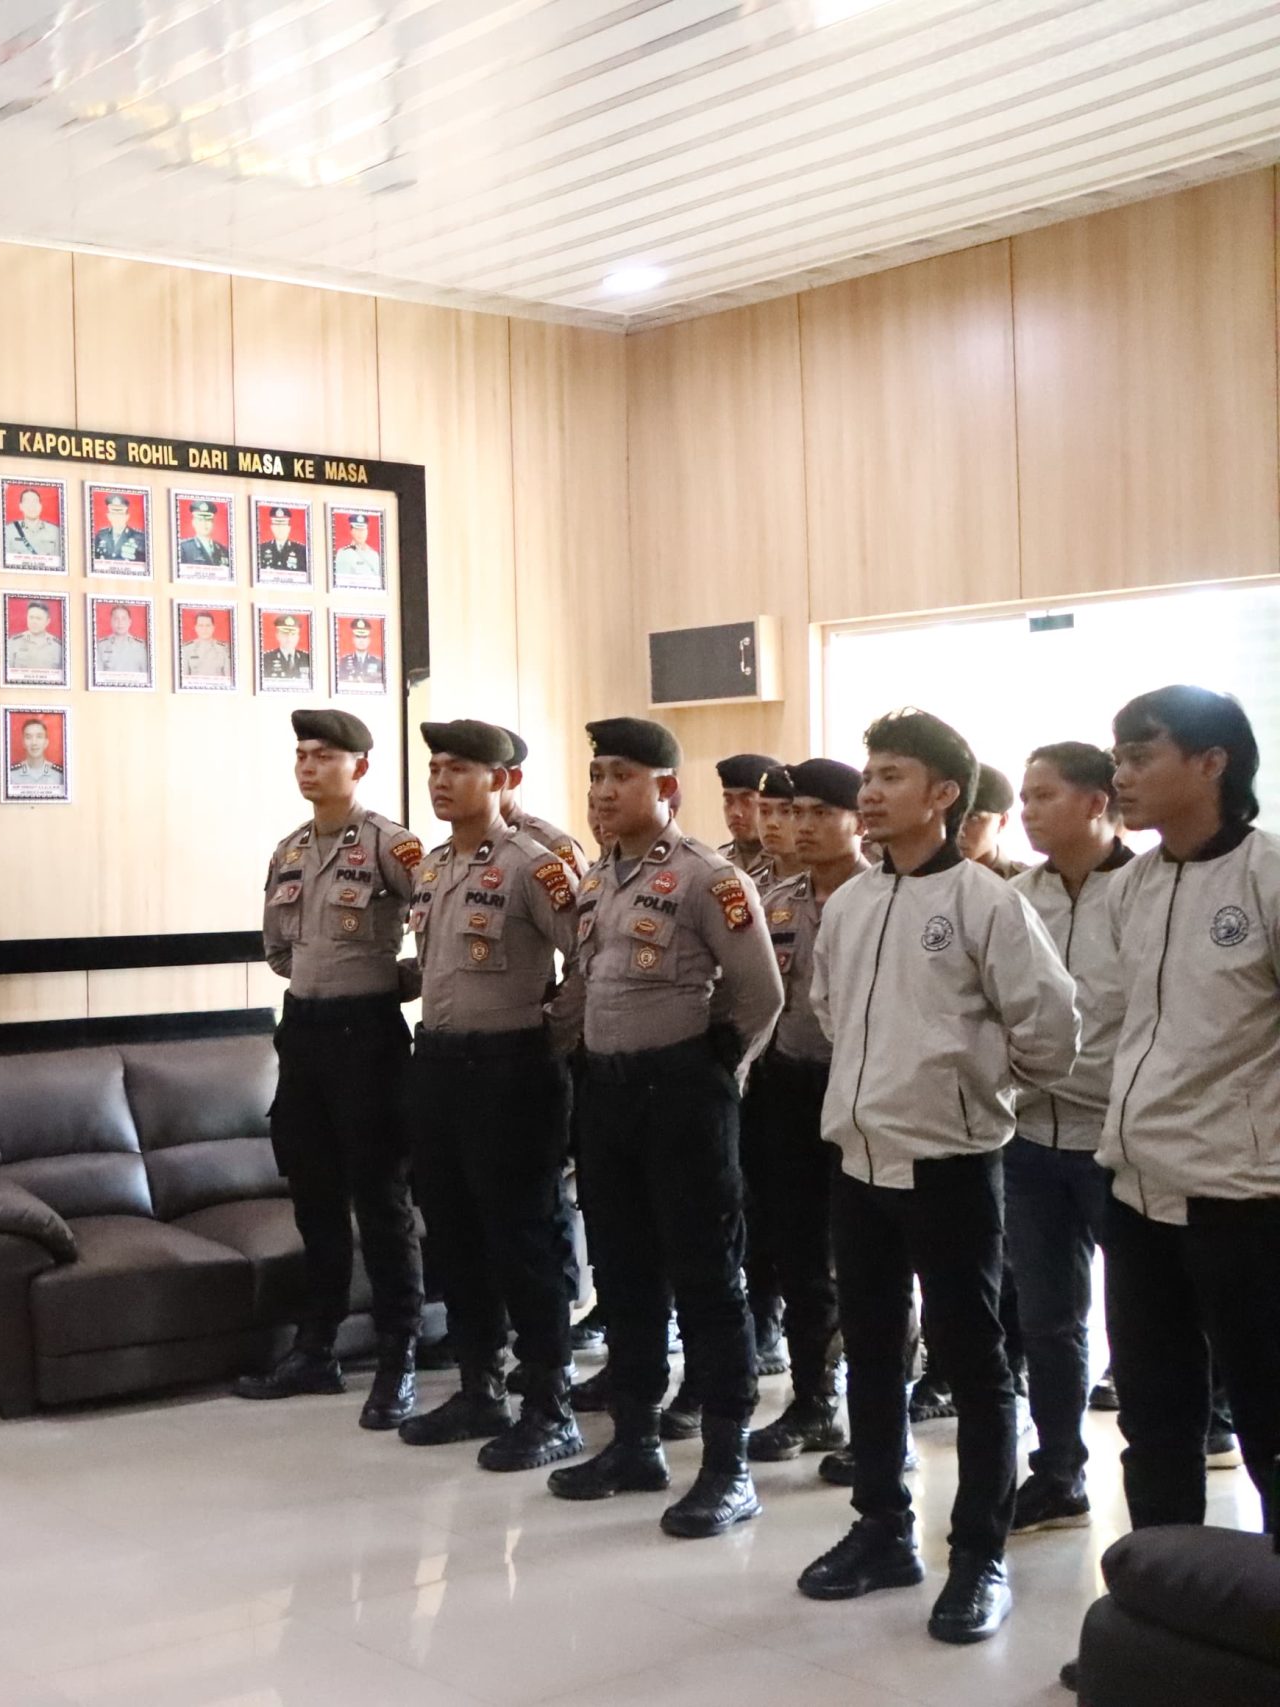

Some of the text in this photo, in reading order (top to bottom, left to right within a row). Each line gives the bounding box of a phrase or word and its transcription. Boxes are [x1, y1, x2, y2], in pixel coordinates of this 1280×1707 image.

[19, 431, 117, 461] KAPOLRES
[127, 442, 178, 466] ROHIL
[188, 448, 228, 471] DARI
[238, 452, 284, 476] MASA
[293, 458, 315, 479] KE
[325, 461, 368, 484] MASA
[336, 869, 371, 884] POLRI
[536, 863, 563, 878] POLRES
[546, 875, 565, 887] RIAU
[712, 879, 741, 894] POLRES
[465, 892, 505, 908] POLRI
[722, 892, 744, 902] RIAU
[634, 894, 678, 916] POLRI
